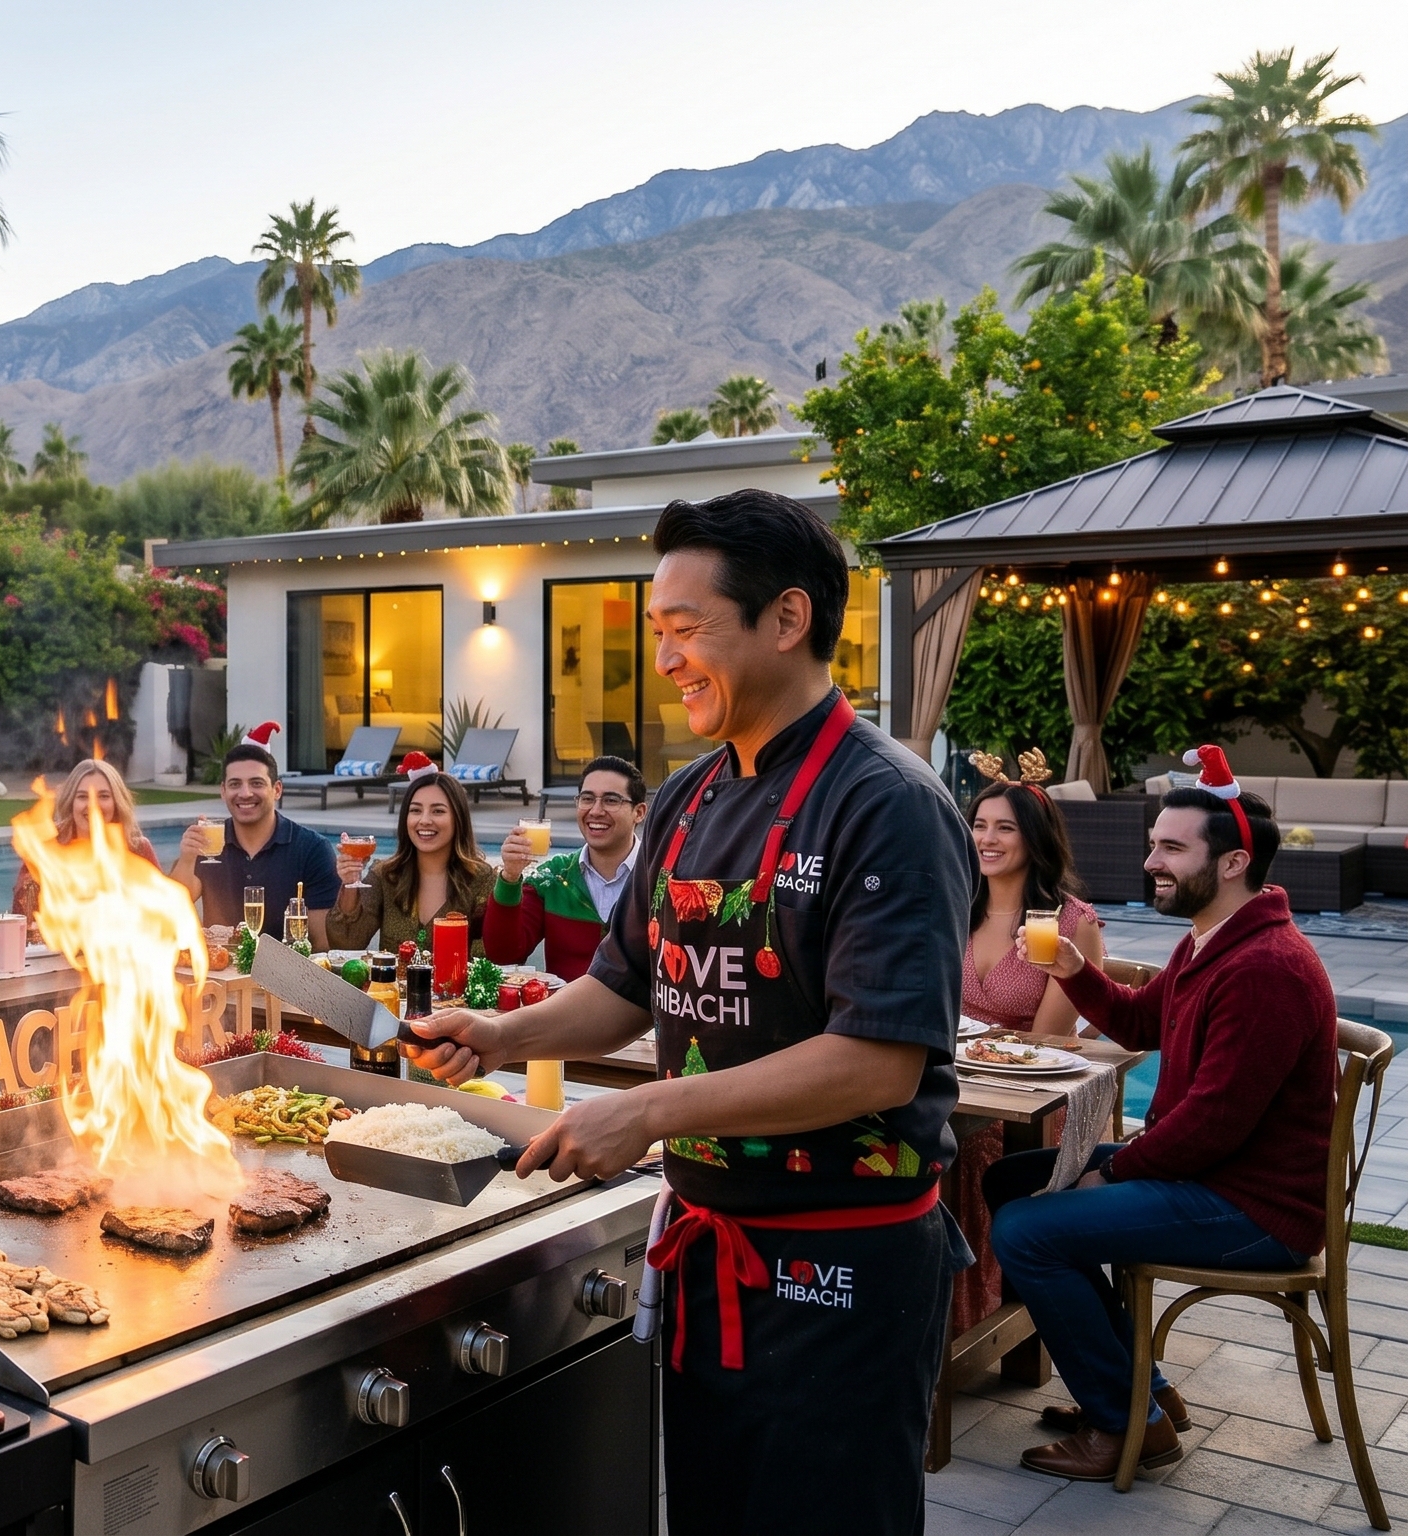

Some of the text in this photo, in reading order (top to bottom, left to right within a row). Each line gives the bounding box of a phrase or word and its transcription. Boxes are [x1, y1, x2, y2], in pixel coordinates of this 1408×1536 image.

[781, 851, 824, 876] OVE
[773, 872, 820, 894] IBACHI
[655, 980, 750, 1026] HIBACHI
[776, 1258, 853, 1290] LOVE
[776, 1281, 852, 1309] HIBACHI
